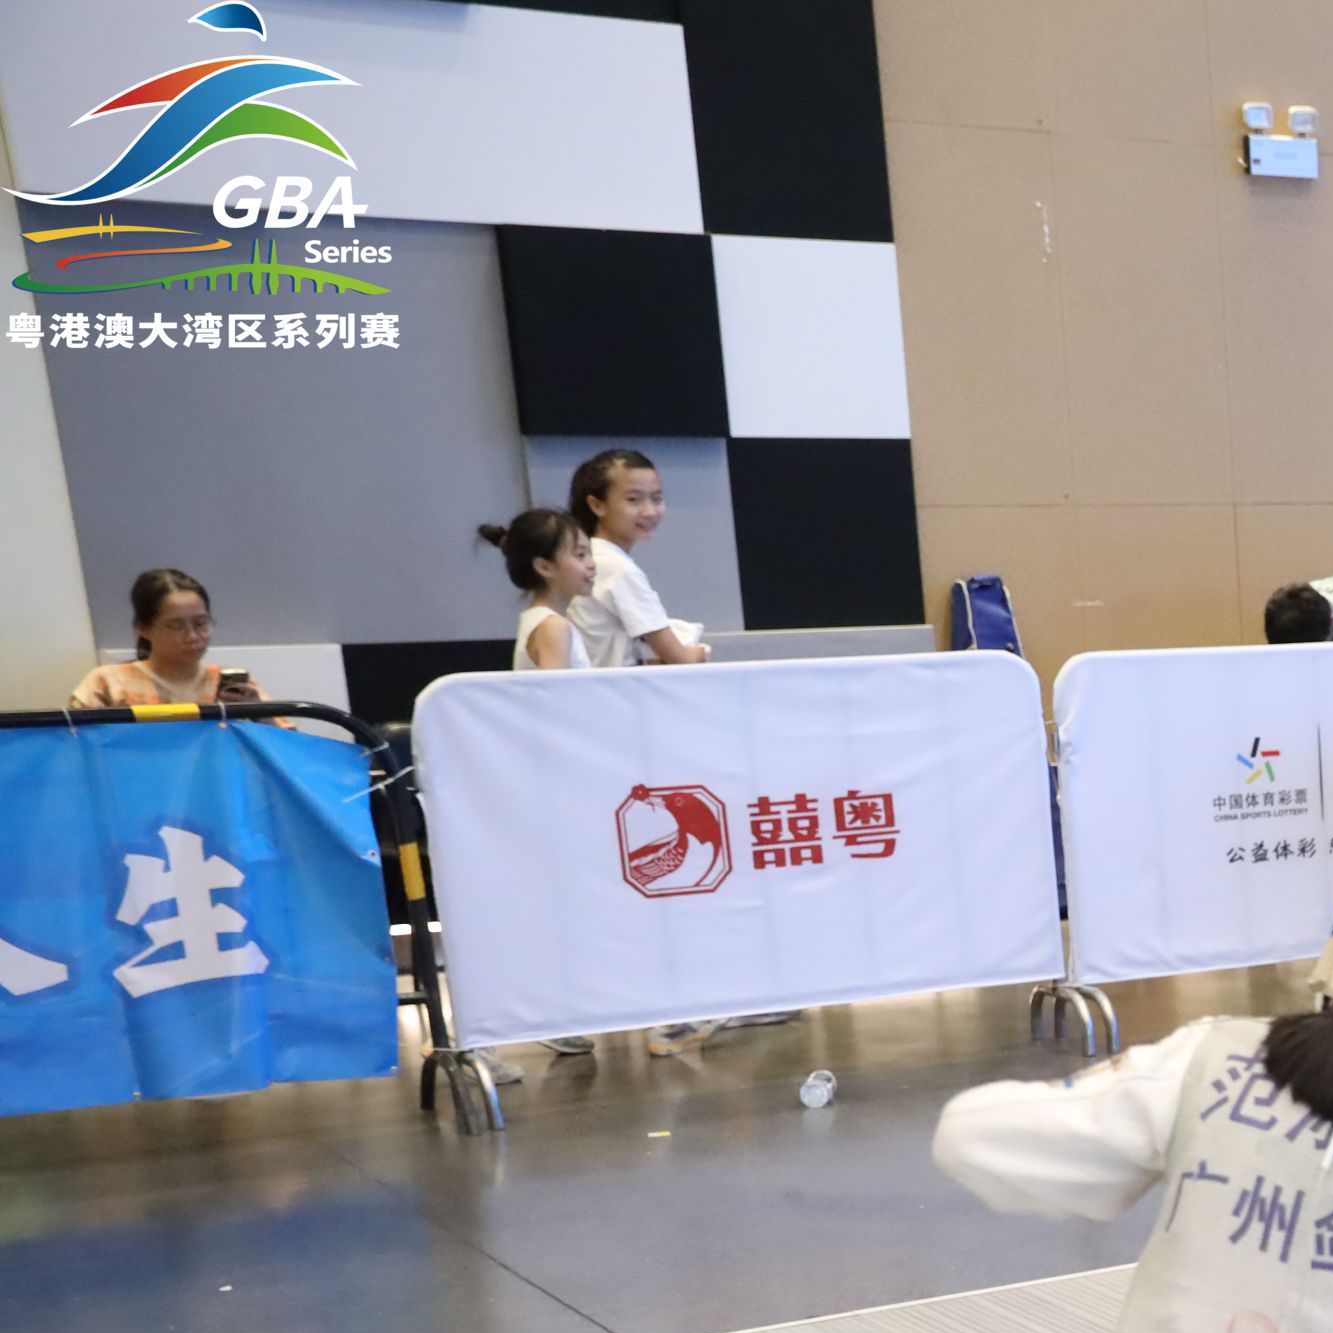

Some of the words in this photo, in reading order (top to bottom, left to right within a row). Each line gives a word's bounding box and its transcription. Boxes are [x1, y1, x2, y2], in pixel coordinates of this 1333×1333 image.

[1213, 788, 1308, 811] 中国体育彩票
[1214, 812, 1239, 823] CHINA
[1240, 810, 1272, 821] SPORTS
[1273, 808, 1309, 819] LOTTERY
[1226, 836, 1318, 864] 公益体彩
